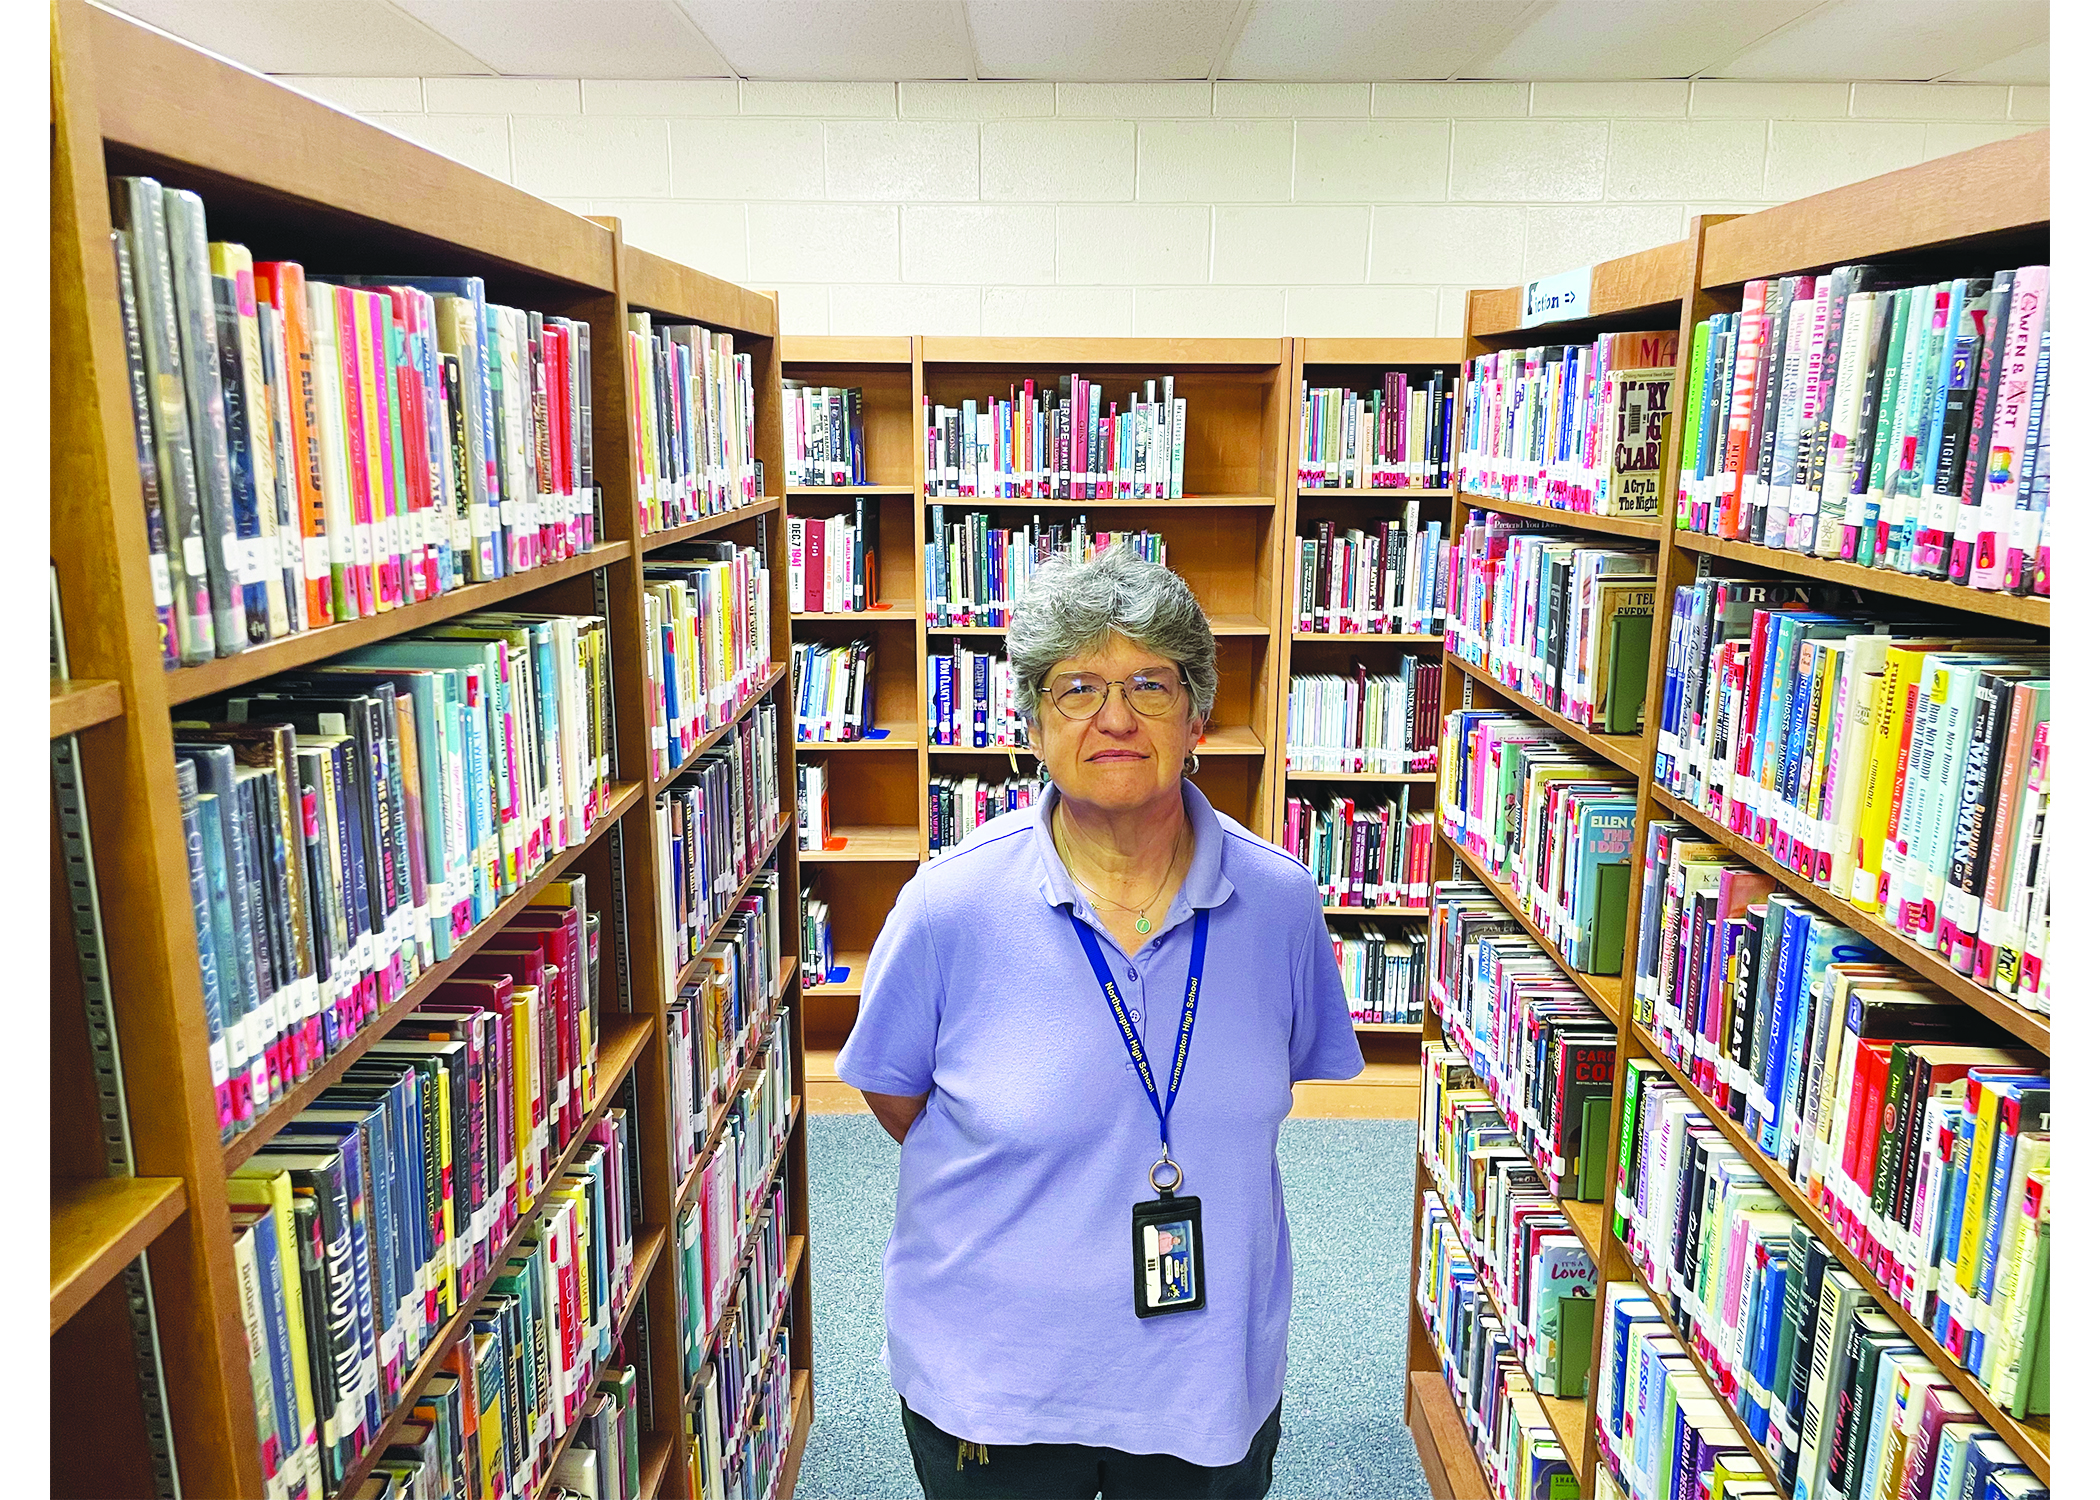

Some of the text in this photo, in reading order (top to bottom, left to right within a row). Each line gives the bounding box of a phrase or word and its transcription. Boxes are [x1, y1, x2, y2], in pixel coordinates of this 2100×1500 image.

[160, 251, 180, 367] SUMMONS
[1527, 282, 1559, 316] Fiction
[1831, 296, 1844, 330] THE
[2014, 292, 2038, 357] GWEN
[119, 249, 153, 446] THE STREET LAWYER
[1783, 356, 1792, 391] TRAIN
[1803, 287, 1829, 419] MICHAEL CRICHTON
[2013, 363, 2024, 374] &
[361, 330, 371, 374] who
[366, 394, 378, 458] kissed
[480, 345, 494, 441] unbroken
[1786, 357, 1801, 420] THE GREAT
[1932, 384, 1946, 427] WOLF
[949, 418, 957, 454] SEASONS
[1796, 429, 1812, 484] STATE OF
[1812, 421, 1829, 492] MICHAE
[1868, 367, 1897, 490] Born of the Sun
[1631, 480, 1645, 496] Cry
[1645, 479, 1655, 492] In
[1937, 433, 1956, 493] TIGHTRO
[1619, 496, 1658, 511] The Night
[1369, 566, 1377, 596] NATIVE
[1425, 550, 1436, 611] INDIAN HERITAG
[1695, 585, 1713, 687] Crutcher whale talk
[940, 660, 951, 674] TOM
[1406, 689, 1415, 745] INDIAN TRIBES
[1781, 693, 1793, 731] GHOSTS
[1793, 702, 1805, 748] THINGS
[1806, 669, 1823, 753] POSSIBILITY
[1880, 661, 1901, 739] running
[1928, 703, 1941, 723] BUD,
[1776, 743, 1788, 784] RANCHO
[1823, 676, 1848, 820] SAY YES SUMMER
[1897, 748, 1908, 772] Bud,
[1920, 749, 1934, 781] BUDDY
[1925, 728, 1937, 748] NOT
[1945, 731, 1956, 752] NOT
[1785, 760, 1799, 791] KNOW
[1893, 776, 1903, 797] Not
[1940, 753, 1952, 786] BUDDY
[1952, 714, 1985, 881] THE MADMAN OF
[379, 802, 390, 836] GIRL
[1591, 816, 1628, 828] ELLEN
[1888, 800, 1900, 835] Buddy
[1986, 694, 2022, 906] CURTIS The MIGHTY Miss MALO
[340, 843, 349, 866] OLD
[1597, 841, 1624, 854] DID
[1603, 829, 1631, 841] THE
[343, 869, 352, 905] WILLIS
[384, 851, 396, 908] MURDER
[346, 908, 355, 940] PLACE
[1778, 917, 1792, 977] JANET
[200, 953, 220, 1034] SORROW
[1732, 947, 1751, 1066] CAKE EAT
[1770, 980, 1785, 1043] DAILEY
[1105, 981, 1155, 1093] Northampton High School
[1170, 977, 1198, 1093] Northampton High School
[1749, 1044, 1760, 1079] Daile
[1802, 1053, 1825, 1139] ACTS OF LO
[423, 1080, 437, 1231] Out From This Place
[1620, 1094, 1634, 1166] LIBERATOR
[1887, 1092, 1910, 1220] BREATH, EYES, MEMORY
[1899, 1101, 1923, 1230] BREATH, EYES, MEMORY
[286, 1208, 298, 1249] ZEELY
[241, 1262, 263, 1361] Brother Rush
[325, 1186, 364, 1401] The BLACK KID
[1630, 1332, 1639, 1373] SARAH
[1852, 1333, 1863, 1360] Sarah
[1638, 1349, 1650, 1417] DESSEN
[1828, 1389, 1853, 1474] Gravity
[1678, 1423, 1692, 1500] SARAH DESS
